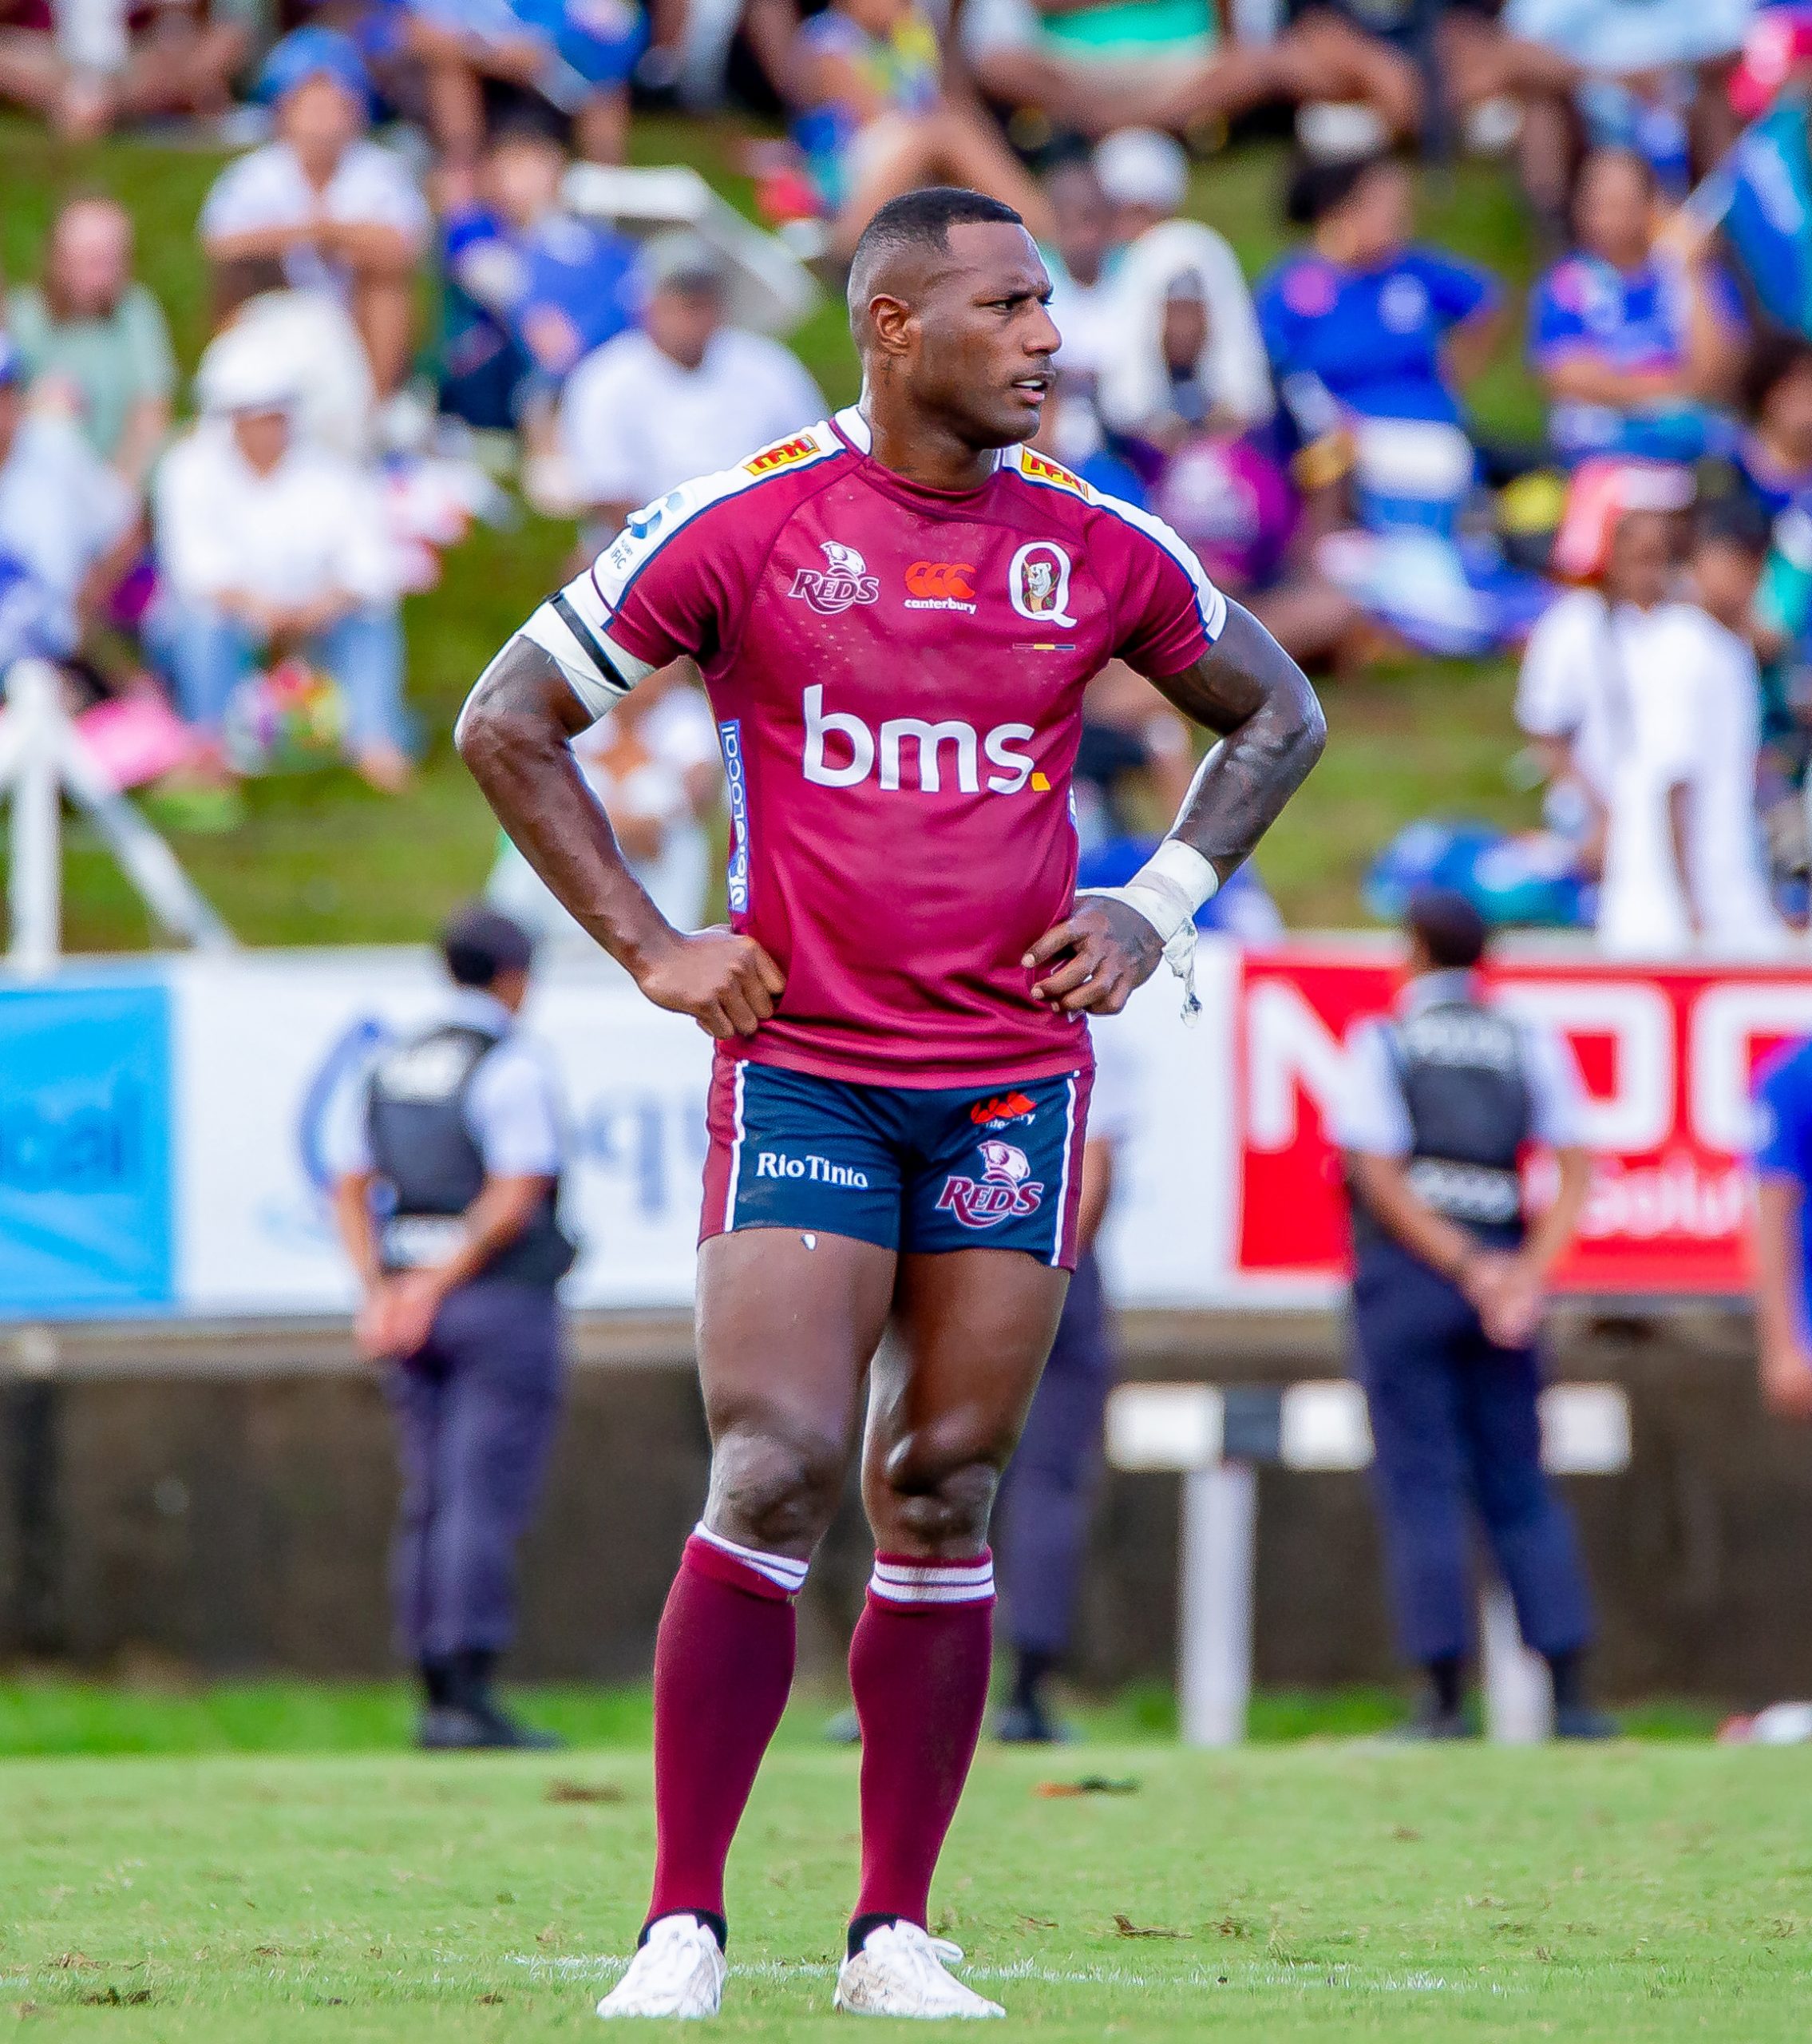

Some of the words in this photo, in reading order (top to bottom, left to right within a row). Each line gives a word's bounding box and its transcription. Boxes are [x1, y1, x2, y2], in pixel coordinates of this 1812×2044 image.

[787, 568, 880, 615] REDS
[904, 597, 977, 615] canterbury
[936, 1175, 1044, 1229] REDS
